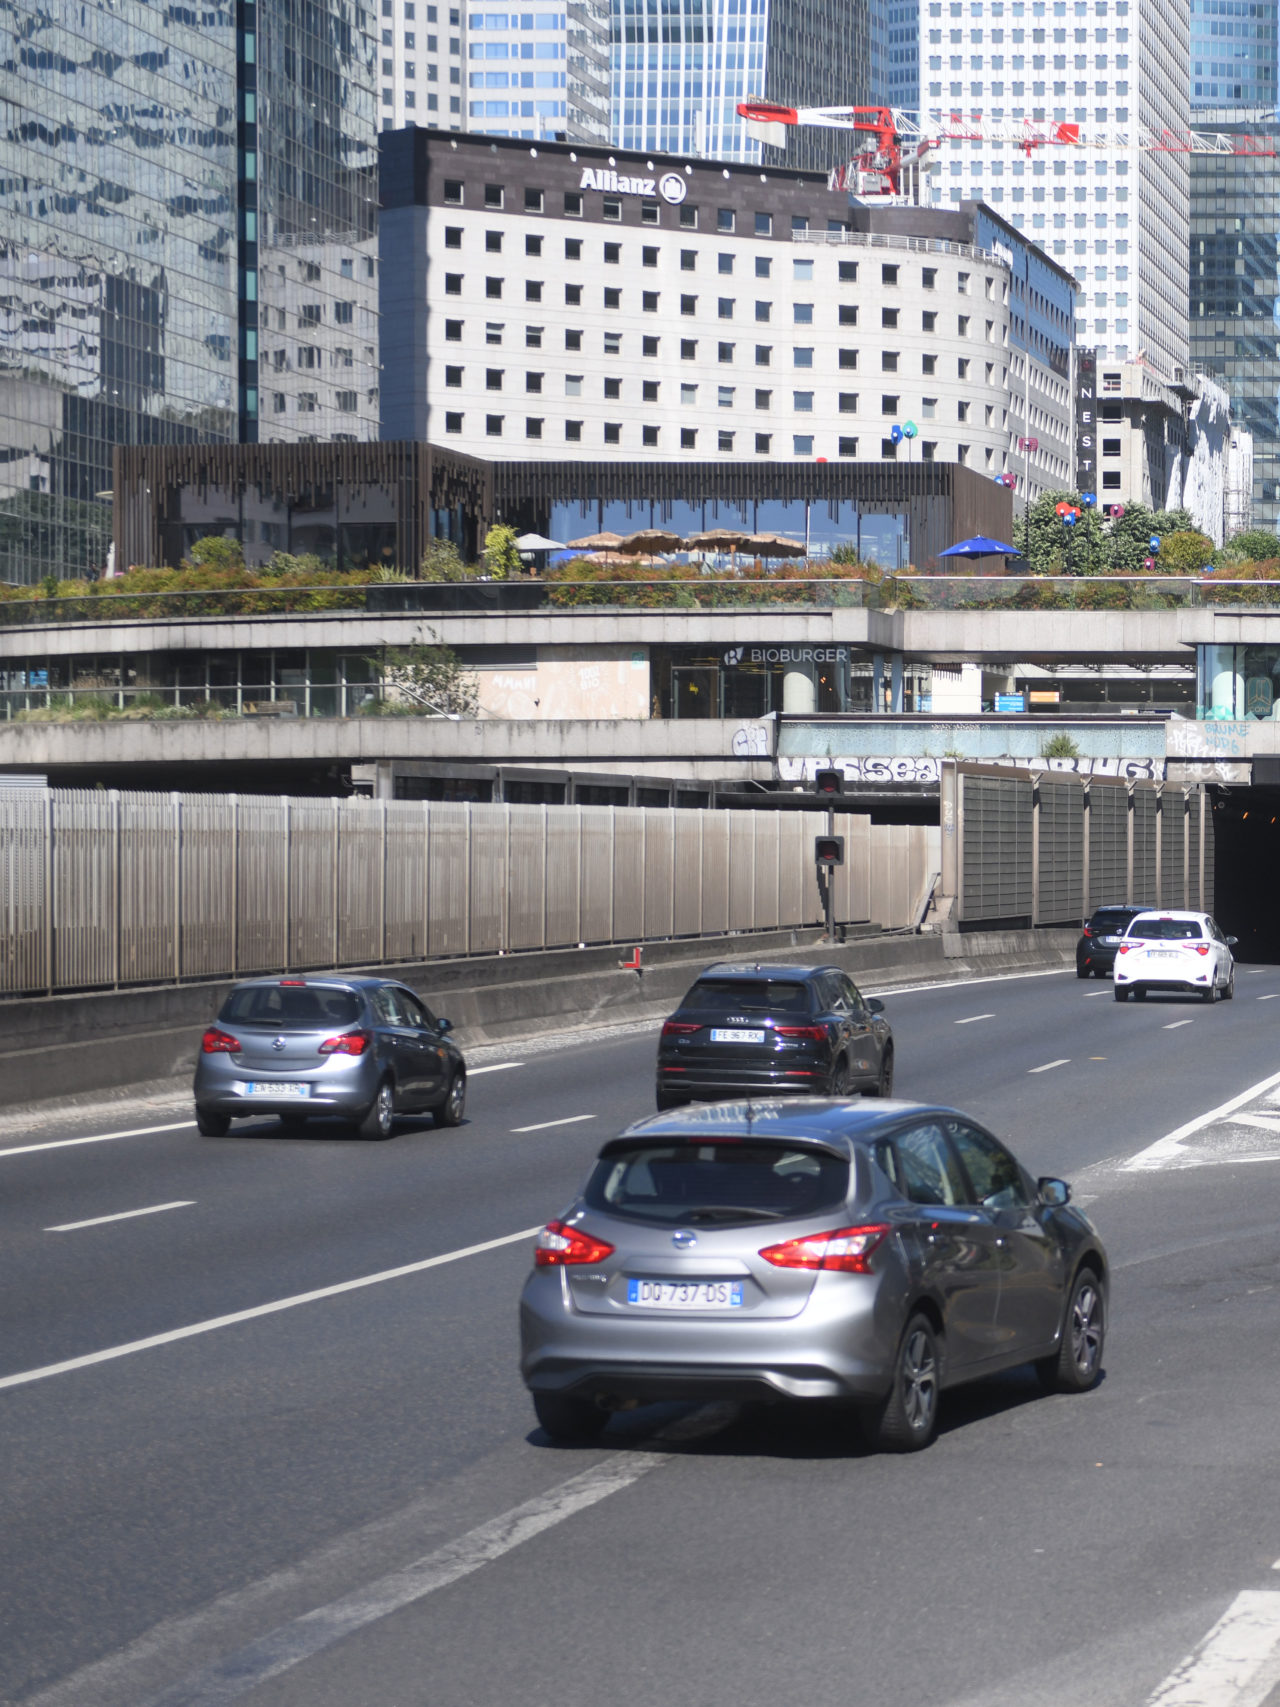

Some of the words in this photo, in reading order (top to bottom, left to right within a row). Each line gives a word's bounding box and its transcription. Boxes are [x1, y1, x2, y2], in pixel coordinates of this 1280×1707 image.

[580, 167, 656, 196] Allianz
[1081, 387, 1092, 471] NEST
[751, 648, 848, 662] BIOBURGER
